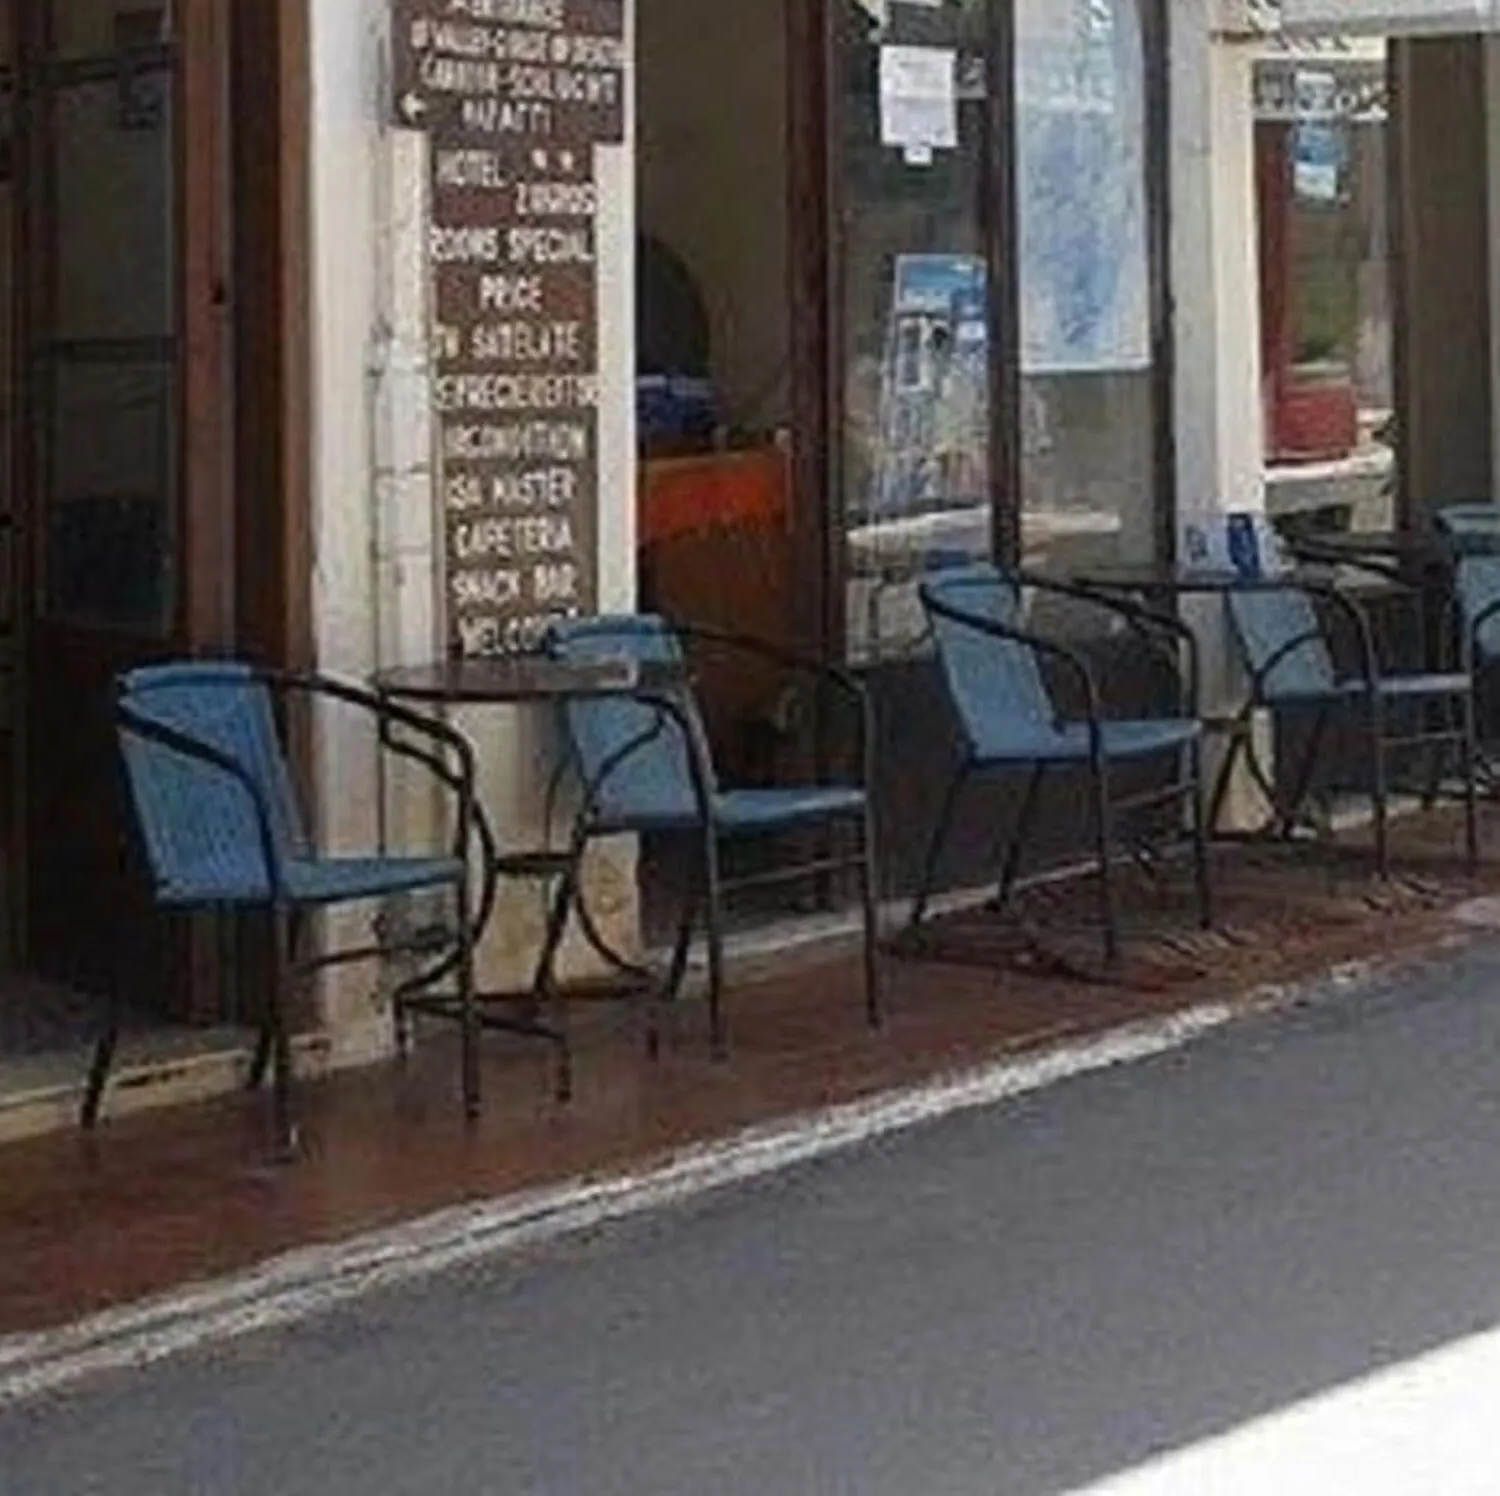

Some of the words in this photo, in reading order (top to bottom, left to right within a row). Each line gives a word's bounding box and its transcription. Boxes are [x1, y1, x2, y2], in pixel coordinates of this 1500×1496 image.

[436, 150, 508, 188] HOTEL
[508, 227, 596, 263] SPECIAL
[479, 274, 543, 311] PRICE
[454, 515, 573, 559] CAFETERIA
[457, 611, 568, 655] WELCO
